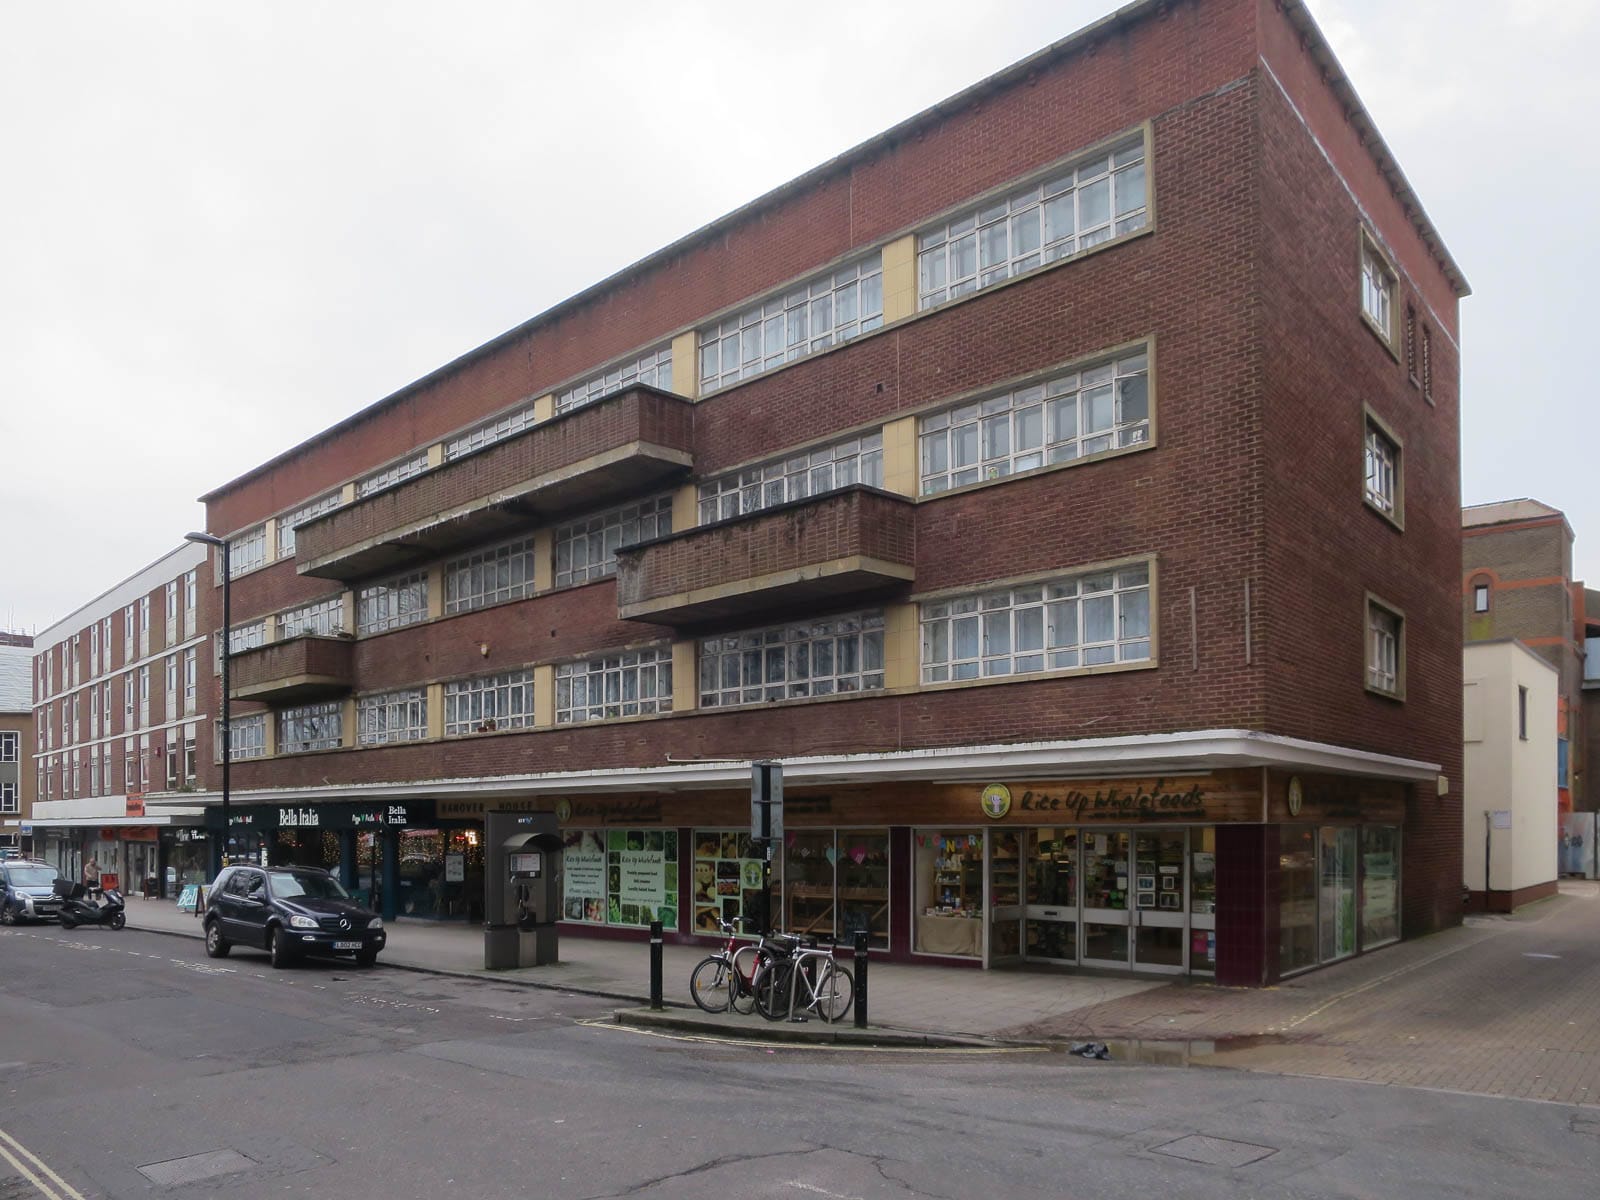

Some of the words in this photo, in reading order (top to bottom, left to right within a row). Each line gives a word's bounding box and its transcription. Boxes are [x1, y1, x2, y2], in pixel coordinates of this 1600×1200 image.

[388, 806, 407, 815] Bella
[279, 808, 298, 826] Bella
[298, 808, 319, 826] Italia
[388, 815, 407, 824] Italia
